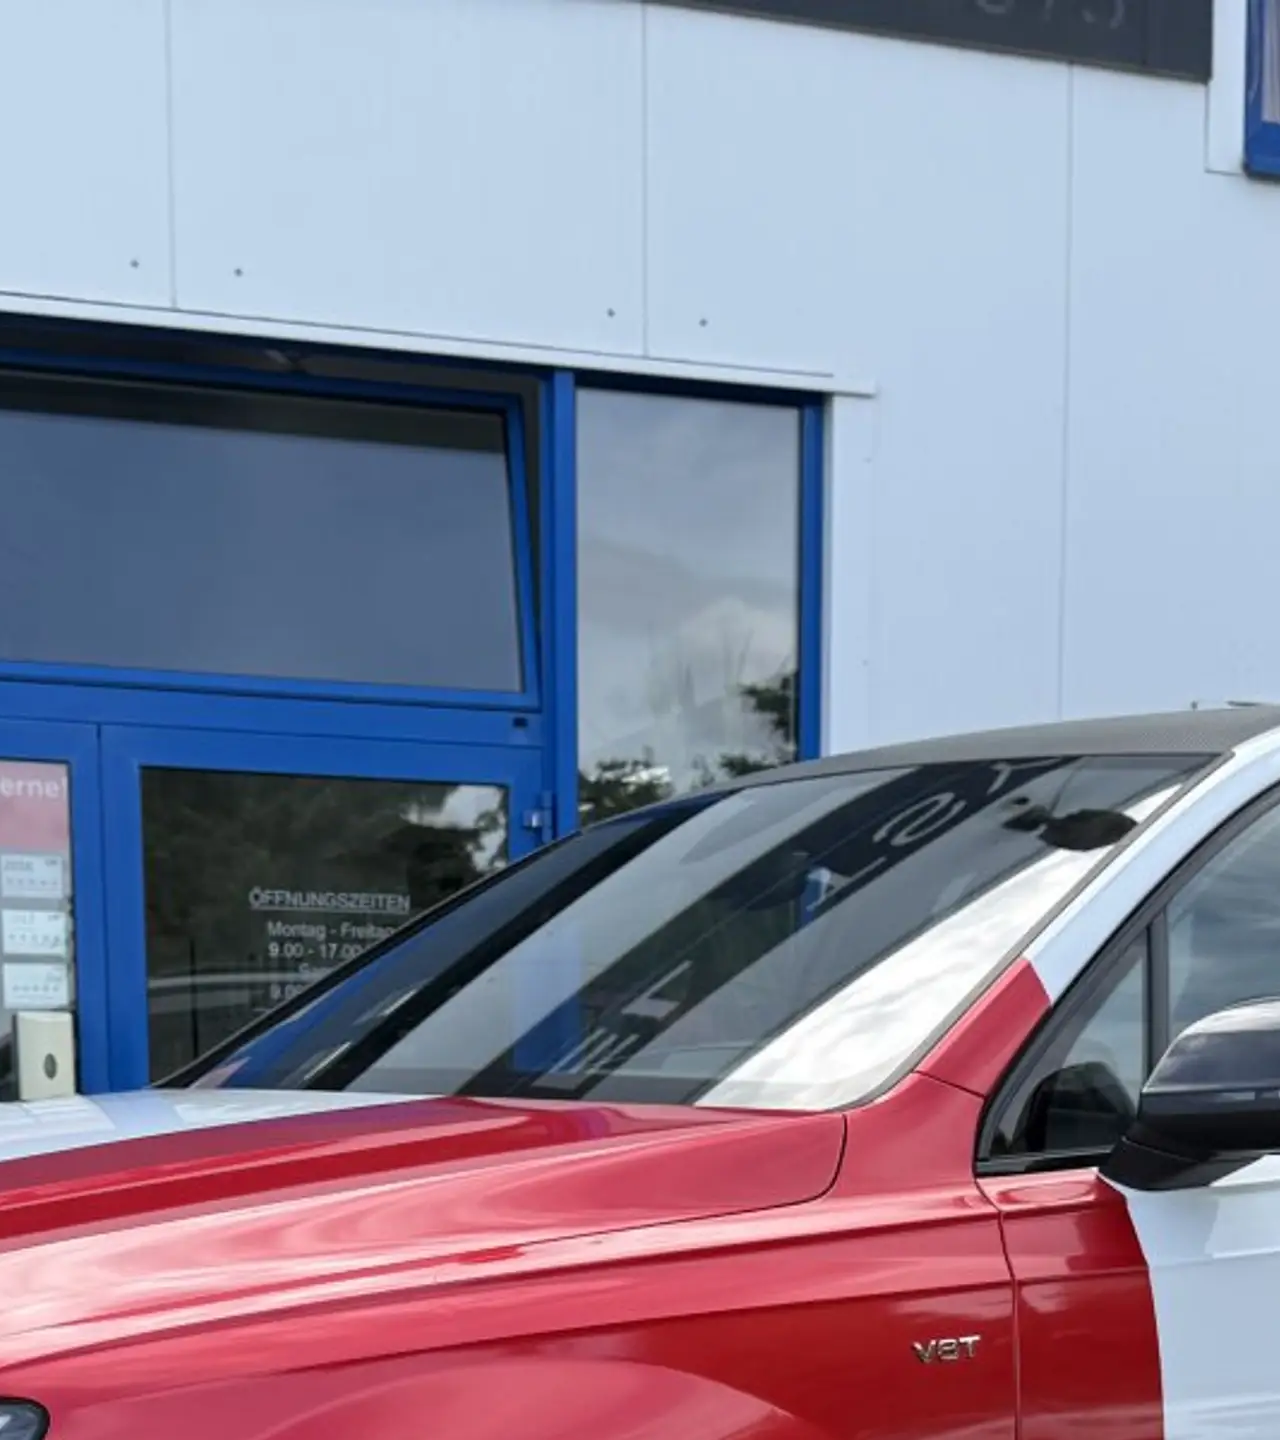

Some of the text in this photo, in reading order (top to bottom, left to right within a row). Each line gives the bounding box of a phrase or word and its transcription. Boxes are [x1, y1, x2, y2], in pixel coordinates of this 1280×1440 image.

[249, 886, 411, 912] ÖFFNUNGSZEITEN
[267, 921, 326, 941] Montag
[912, 1334, 982, 1364] V8T
